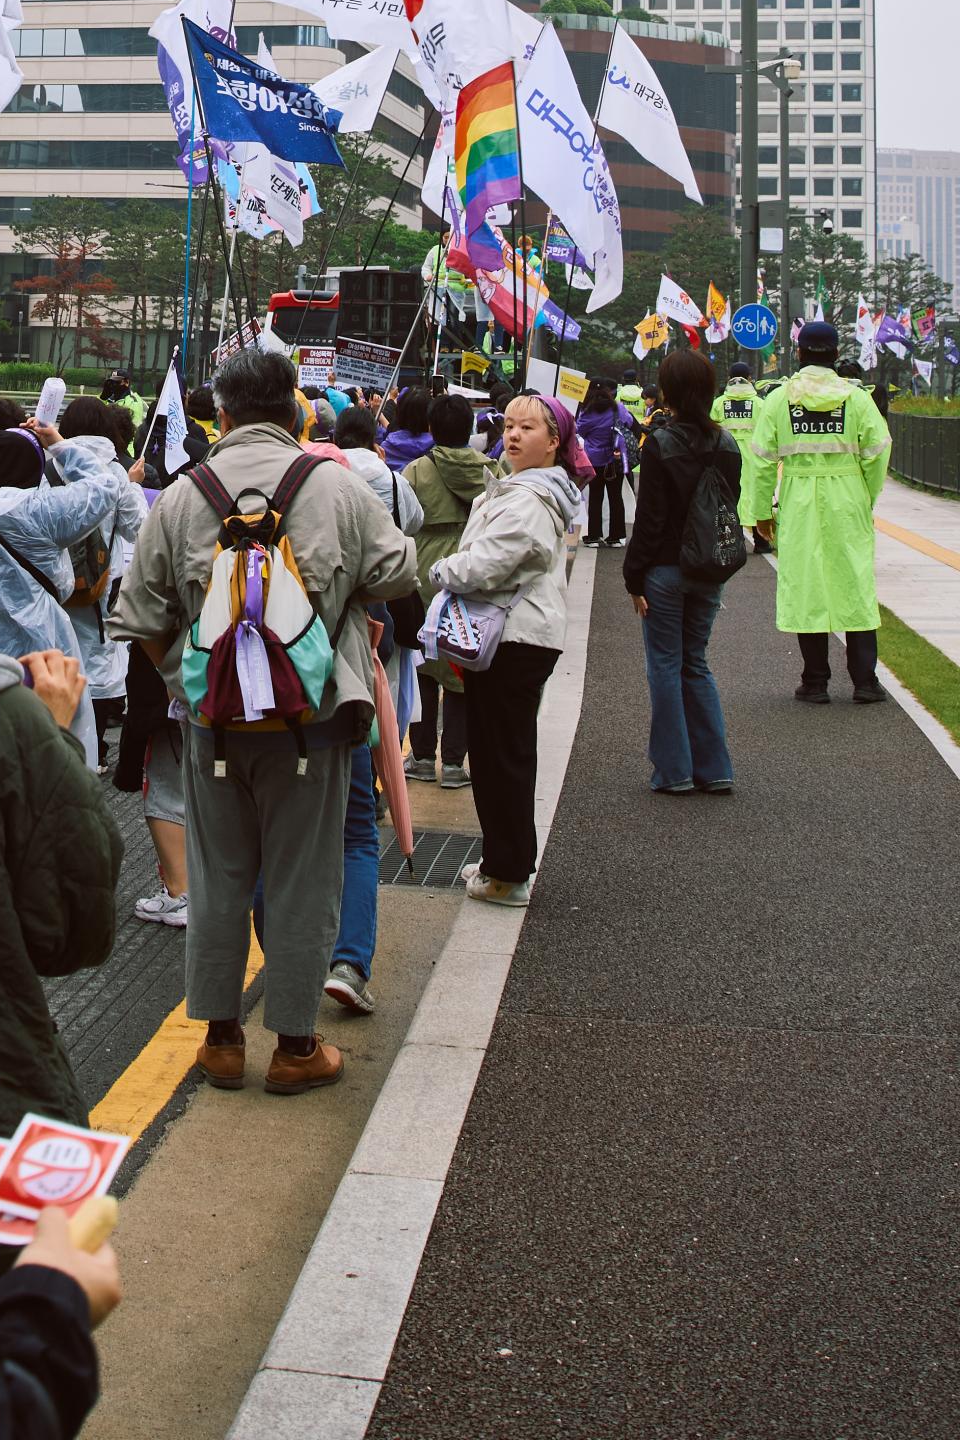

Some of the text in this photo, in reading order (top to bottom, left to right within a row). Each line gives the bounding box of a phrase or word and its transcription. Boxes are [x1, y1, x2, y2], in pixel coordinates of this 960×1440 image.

[298, 122, 321, 133] Since
[724, 411, 752, 419] POLICE
[793, 422, 843, 433] POLICE
